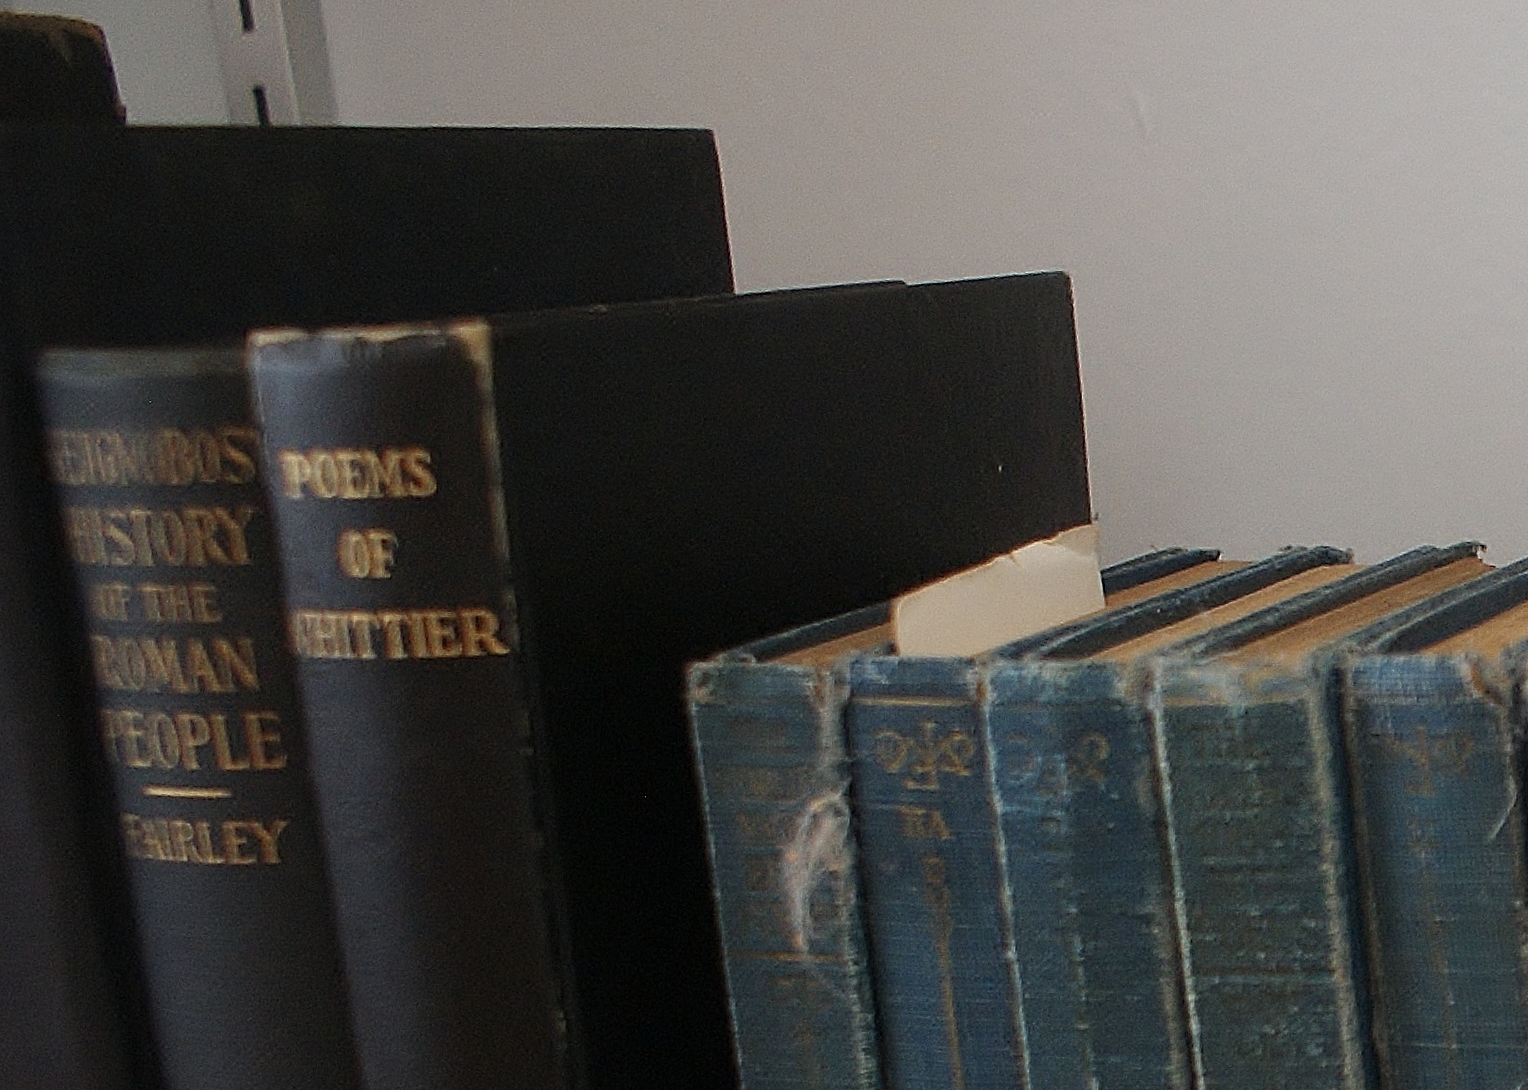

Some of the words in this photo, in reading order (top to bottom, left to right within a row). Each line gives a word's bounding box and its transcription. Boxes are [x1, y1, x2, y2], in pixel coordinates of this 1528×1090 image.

[278, 447, 439, 500] POEMS
[337, 527, 399, 580] OF
[135, 582, 223, 624] THE
[91, 633, 259, 693] ROMAN
[101, 708, 288, 771] PEOPLE
